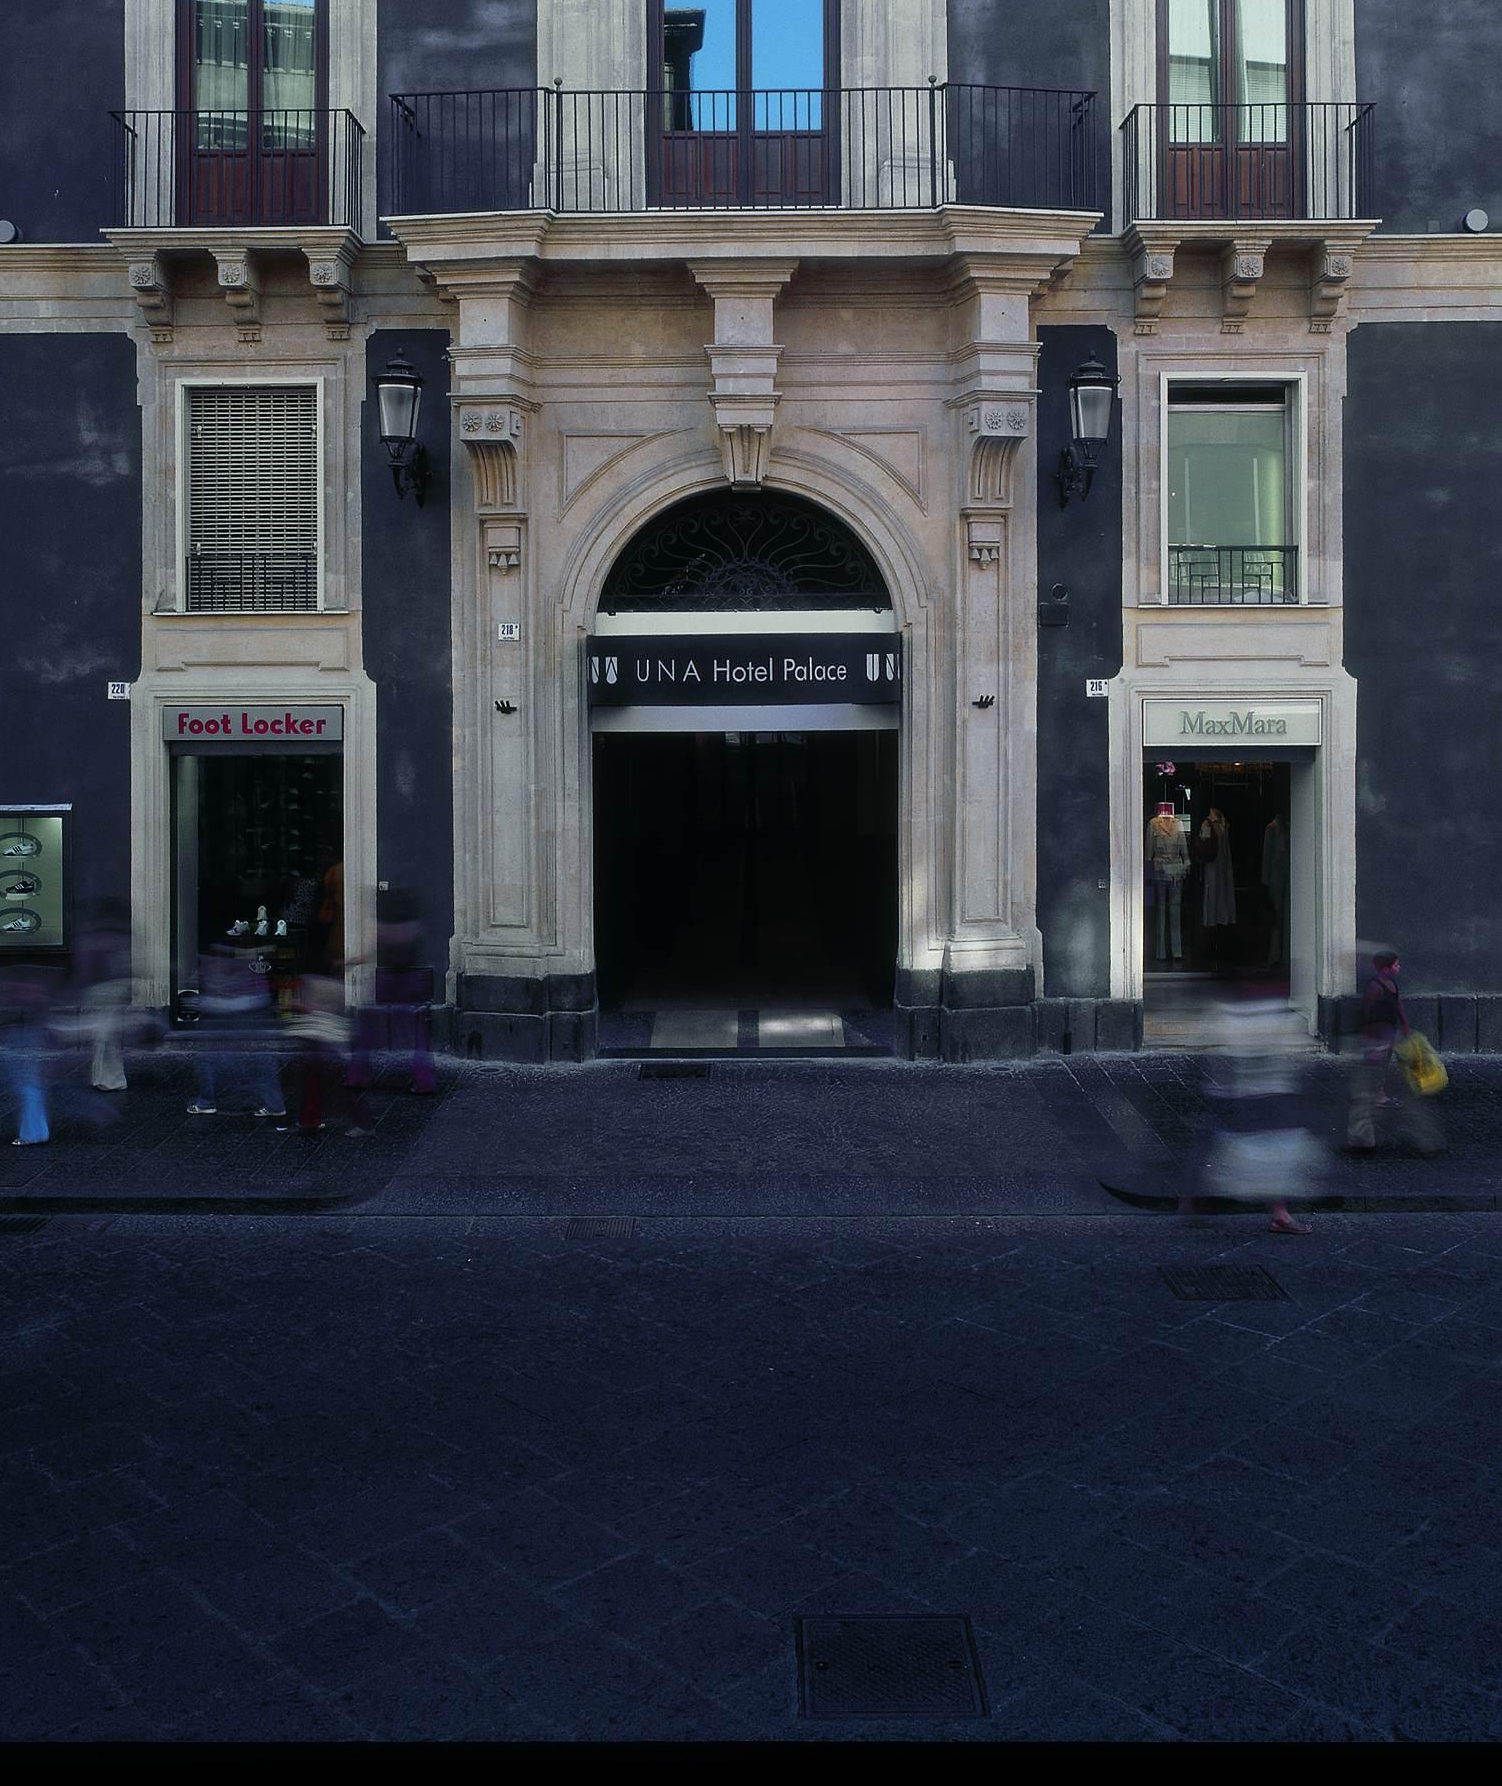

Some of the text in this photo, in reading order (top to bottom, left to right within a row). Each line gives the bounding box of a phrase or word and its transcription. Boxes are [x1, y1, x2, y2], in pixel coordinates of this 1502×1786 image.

[635, 656, 848, 683] UNA Hotel Palace
[177, 712, 327, 735] Foot Locker
[1179, 710, 1287, 736] MaxMara
